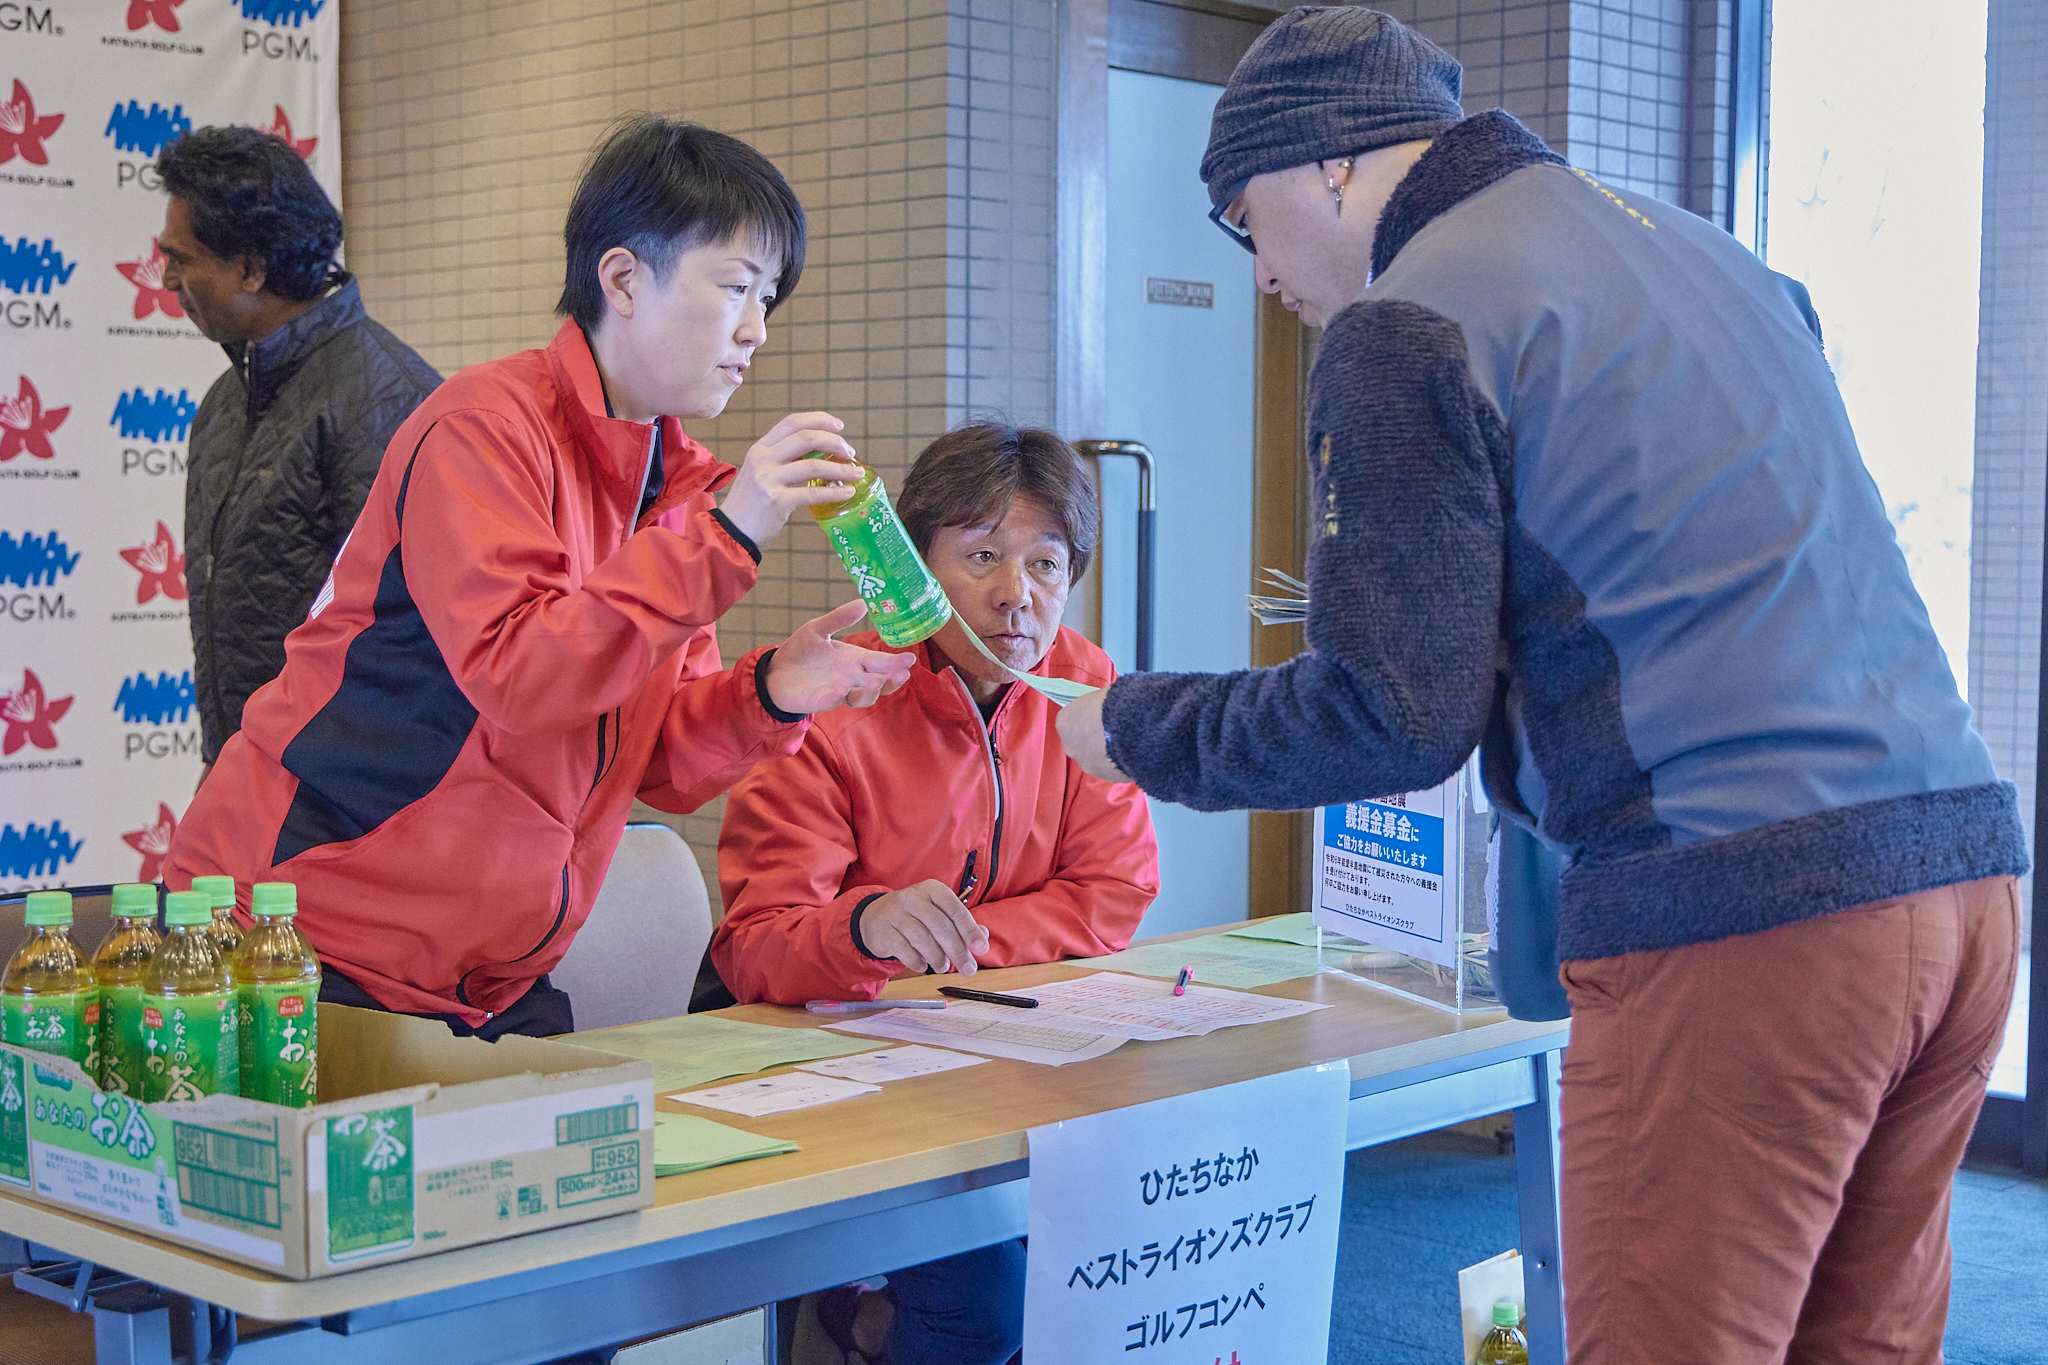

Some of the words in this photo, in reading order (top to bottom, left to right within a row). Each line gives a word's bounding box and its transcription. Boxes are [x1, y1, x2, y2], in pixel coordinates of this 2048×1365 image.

[0, 301, 62, 329] GM
[0, 594, 66, 622] GM
[1345, 802, 1420, 843] 義援金募金に
[1337, 833, 1428, 869] ご協力をお願いいたします
[607, 1146, 636, 1167] 952
[1140, 1146, 1260, 1206] ひたちなか
[1067, 1194, 1318, 1290] ベストライオンズクラブ
[1124, 1282, 1267, 1352] ゴルフコンペ
